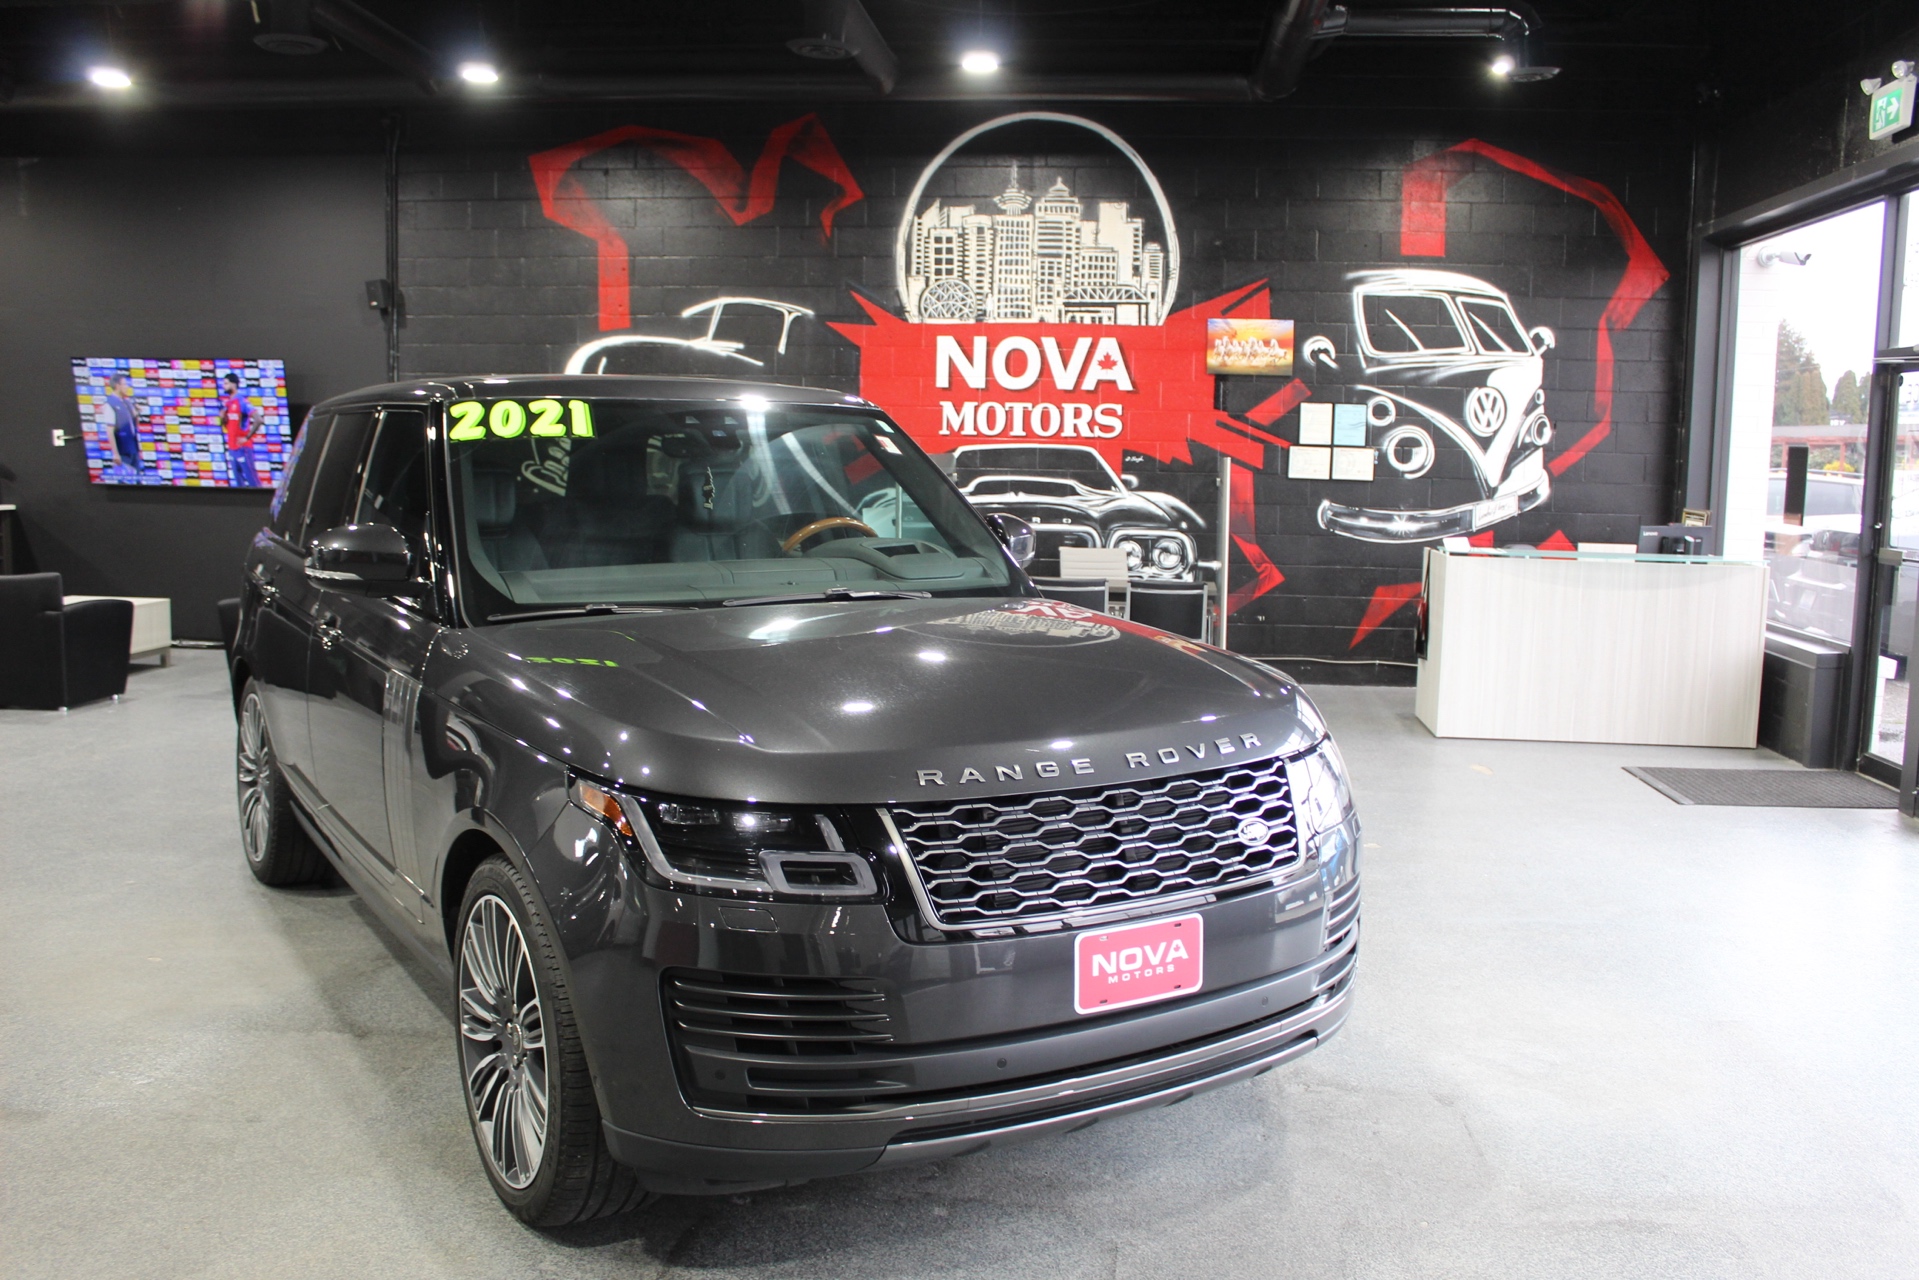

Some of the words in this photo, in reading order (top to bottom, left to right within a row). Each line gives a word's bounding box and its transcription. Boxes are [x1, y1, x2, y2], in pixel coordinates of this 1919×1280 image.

[935, 336, 1134, 391] NOVA
[449, 399, 594, 441] 2021
[938, 400, 1123, 439] MOTORS
[916, 758, 1095, 786] RANGE
[1125, 732, 1262, 769] ROVER
[1092, 939, 1189, 977] NOVA
[1107, 964, 1175, 985] MOTORS
